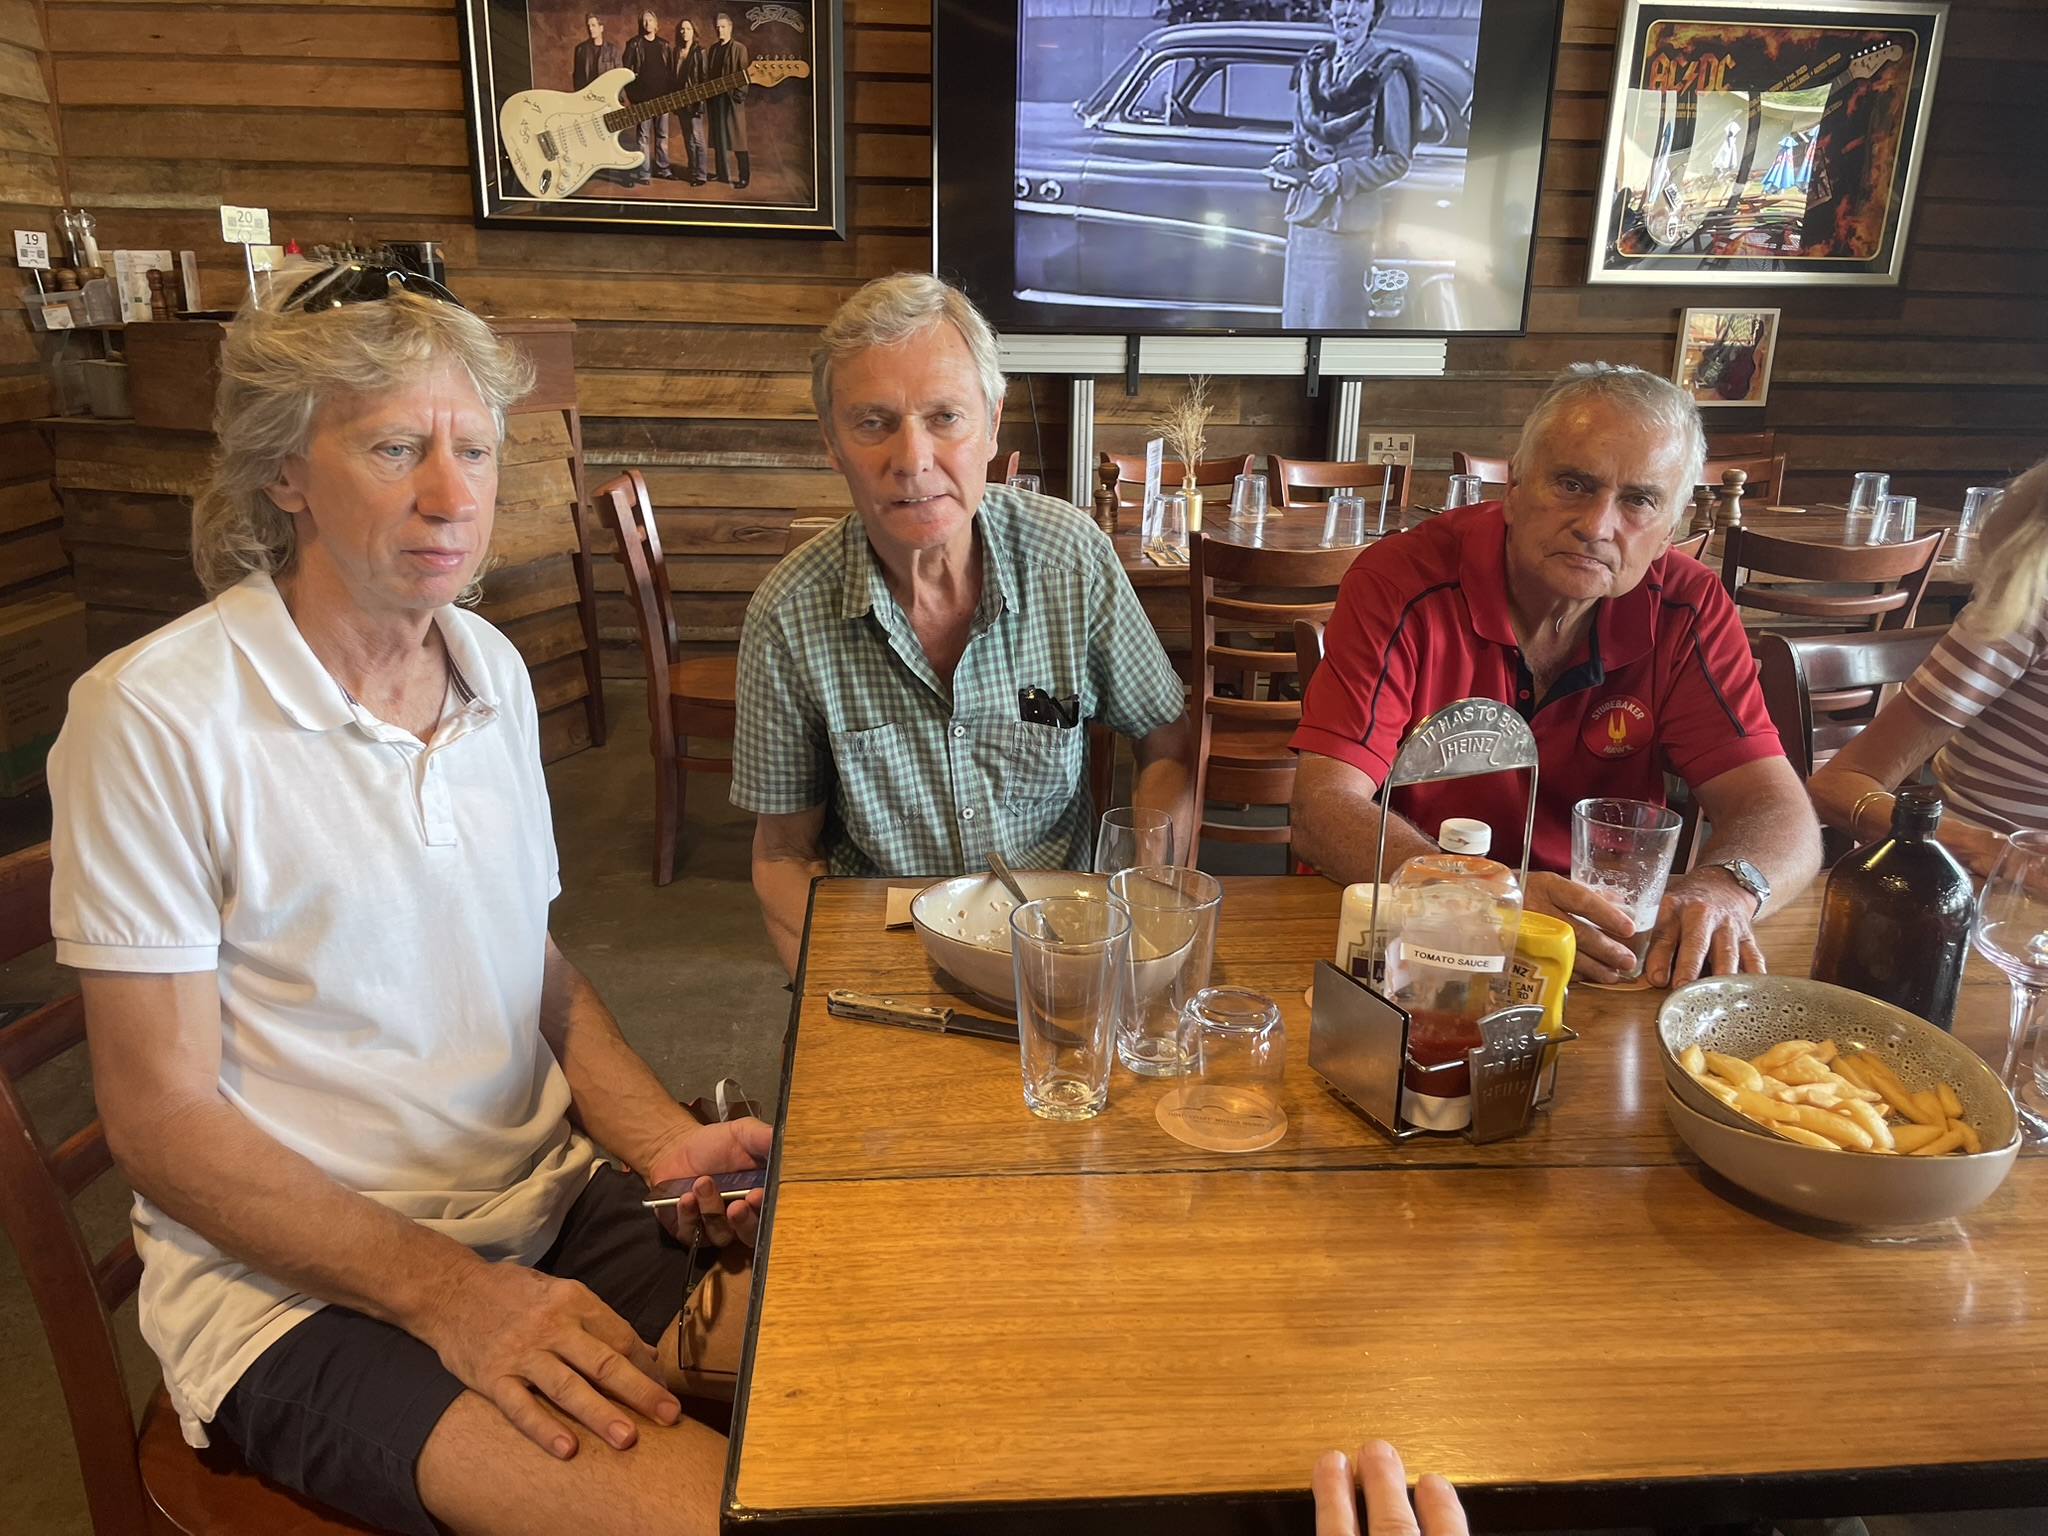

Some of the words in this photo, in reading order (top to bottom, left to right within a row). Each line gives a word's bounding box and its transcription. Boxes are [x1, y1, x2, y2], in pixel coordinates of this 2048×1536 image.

[237, 210, 253, 223] 20
[24, 233, 39, 246] 19
[1387, 436, 1394, 448] 1
[1592, 700, 1645, 720] STUDEBAKER
[1420, 726, 1436, 747] IT
[1438, 706, 1474, 734] HAS
[1477, 705, 1498, 721] TO
[1499, 711, 1520, 736] BE
[1446, 737, 1495, 760] HEINZ
[1603, 744, 1635, 754] HAWK
[1414, 950, 1455, 965] TOMATO
[1458, 957, 1490, 968] SAUCE
